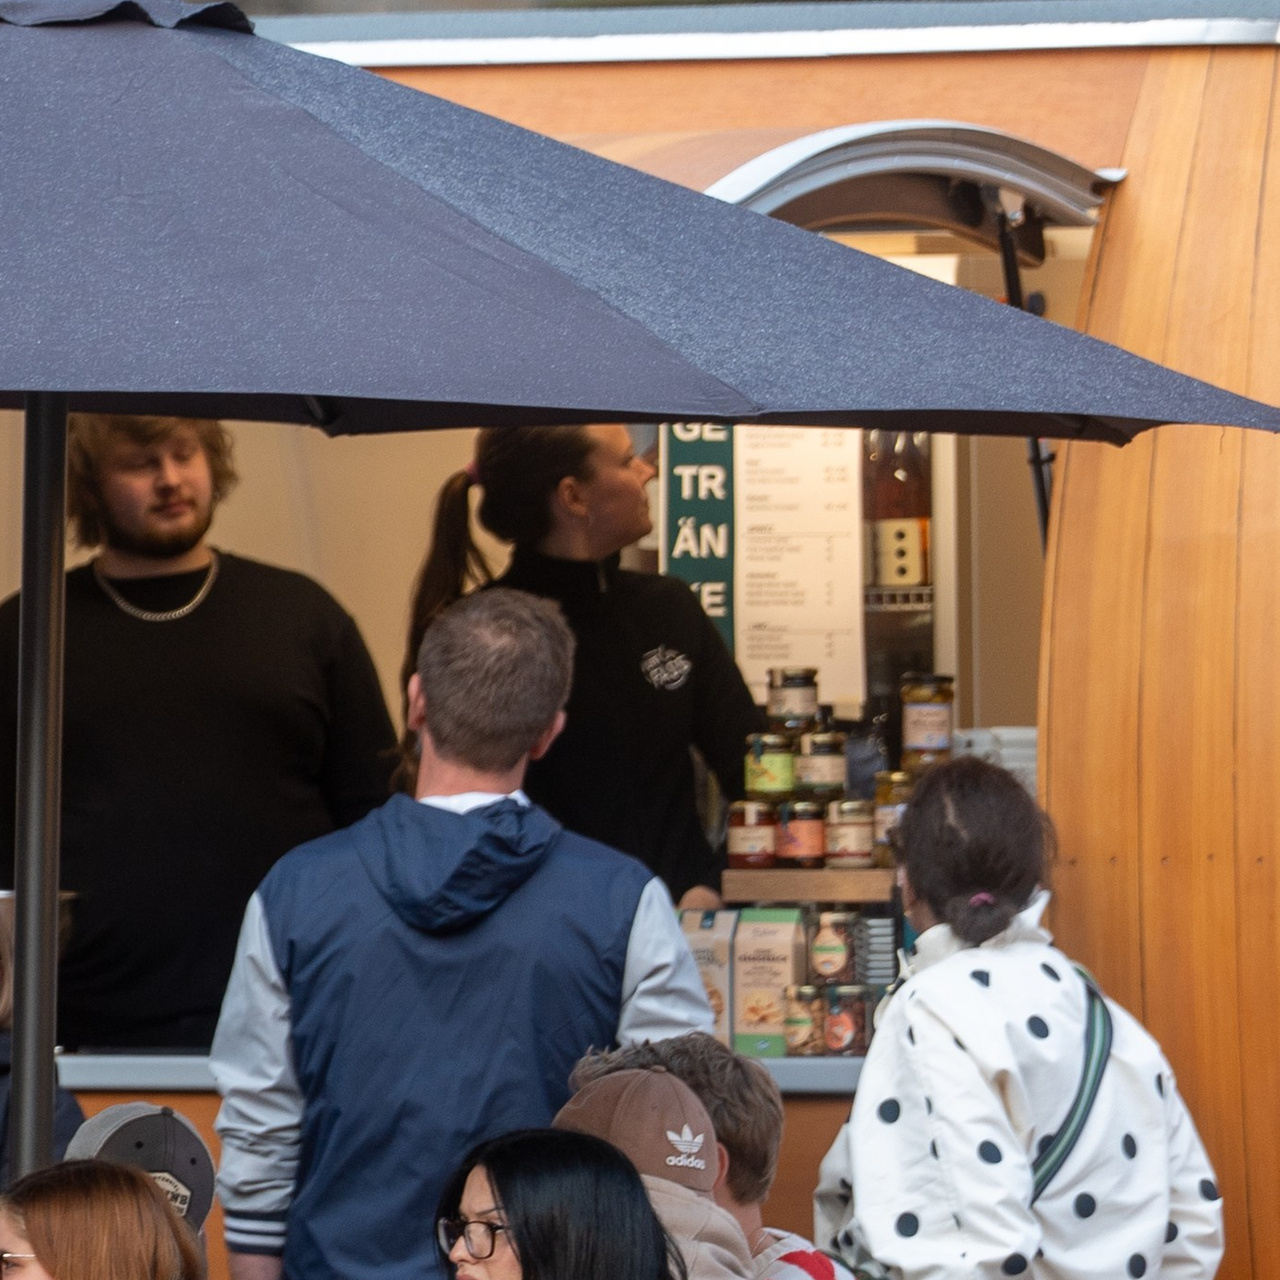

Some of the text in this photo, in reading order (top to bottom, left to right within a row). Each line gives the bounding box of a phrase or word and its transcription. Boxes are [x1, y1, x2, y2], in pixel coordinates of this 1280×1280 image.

[672, 422, 729, 442] GE
[673, 464, 726, 500] TR
[672, 515, 728, 559] ÄN
[689, 581, 728, 618] E
[665, 1153, 706, 1170] adidas
